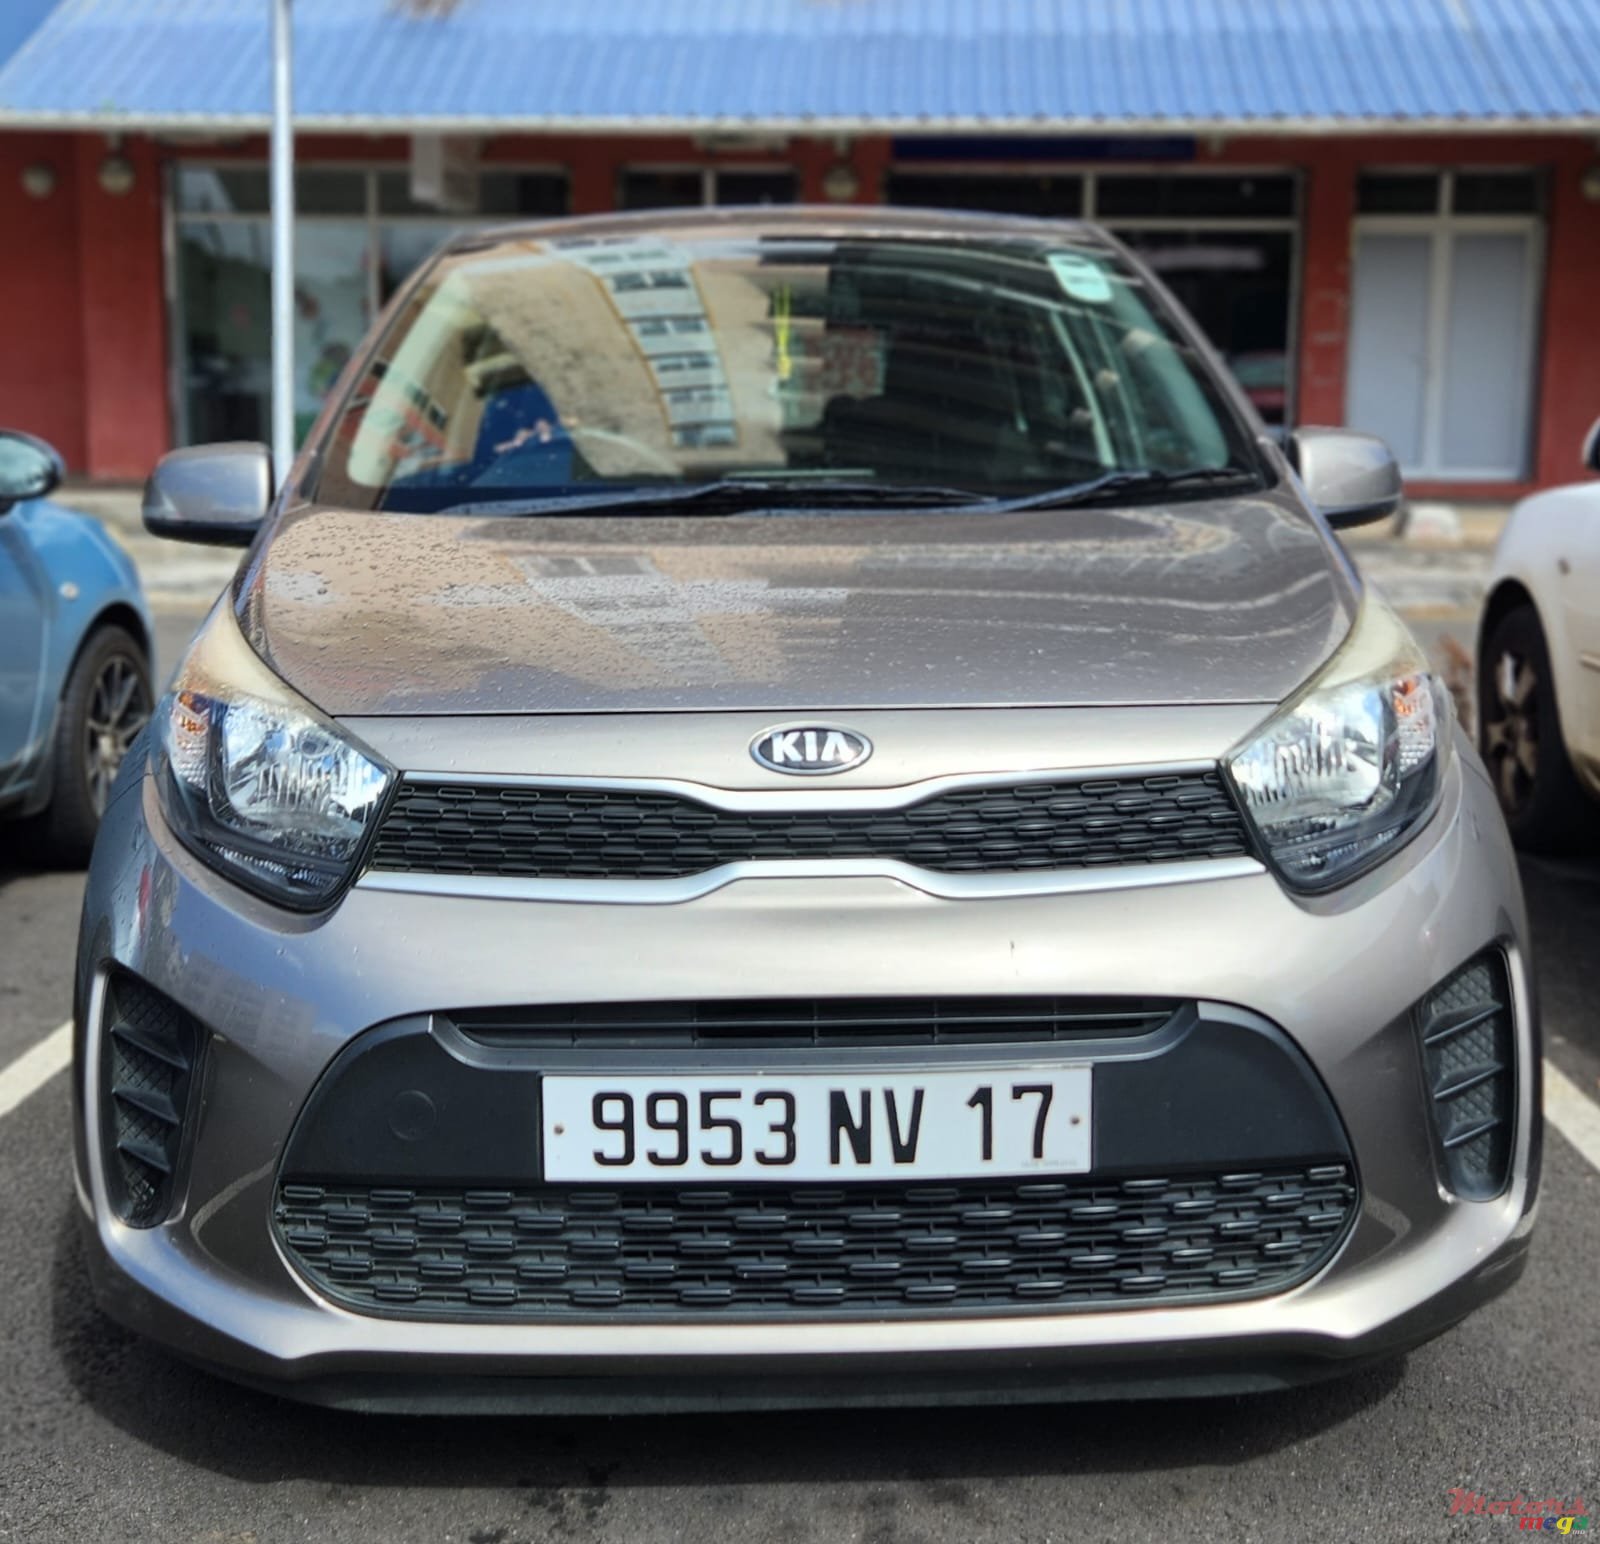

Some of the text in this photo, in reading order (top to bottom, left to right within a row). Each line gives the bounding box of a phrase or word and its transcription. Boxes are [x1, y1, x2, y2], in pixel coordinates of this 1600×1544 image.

[771, 731, 855, 763] KIA
[592, 1083, 1054, 1166] 9953 NV 17
